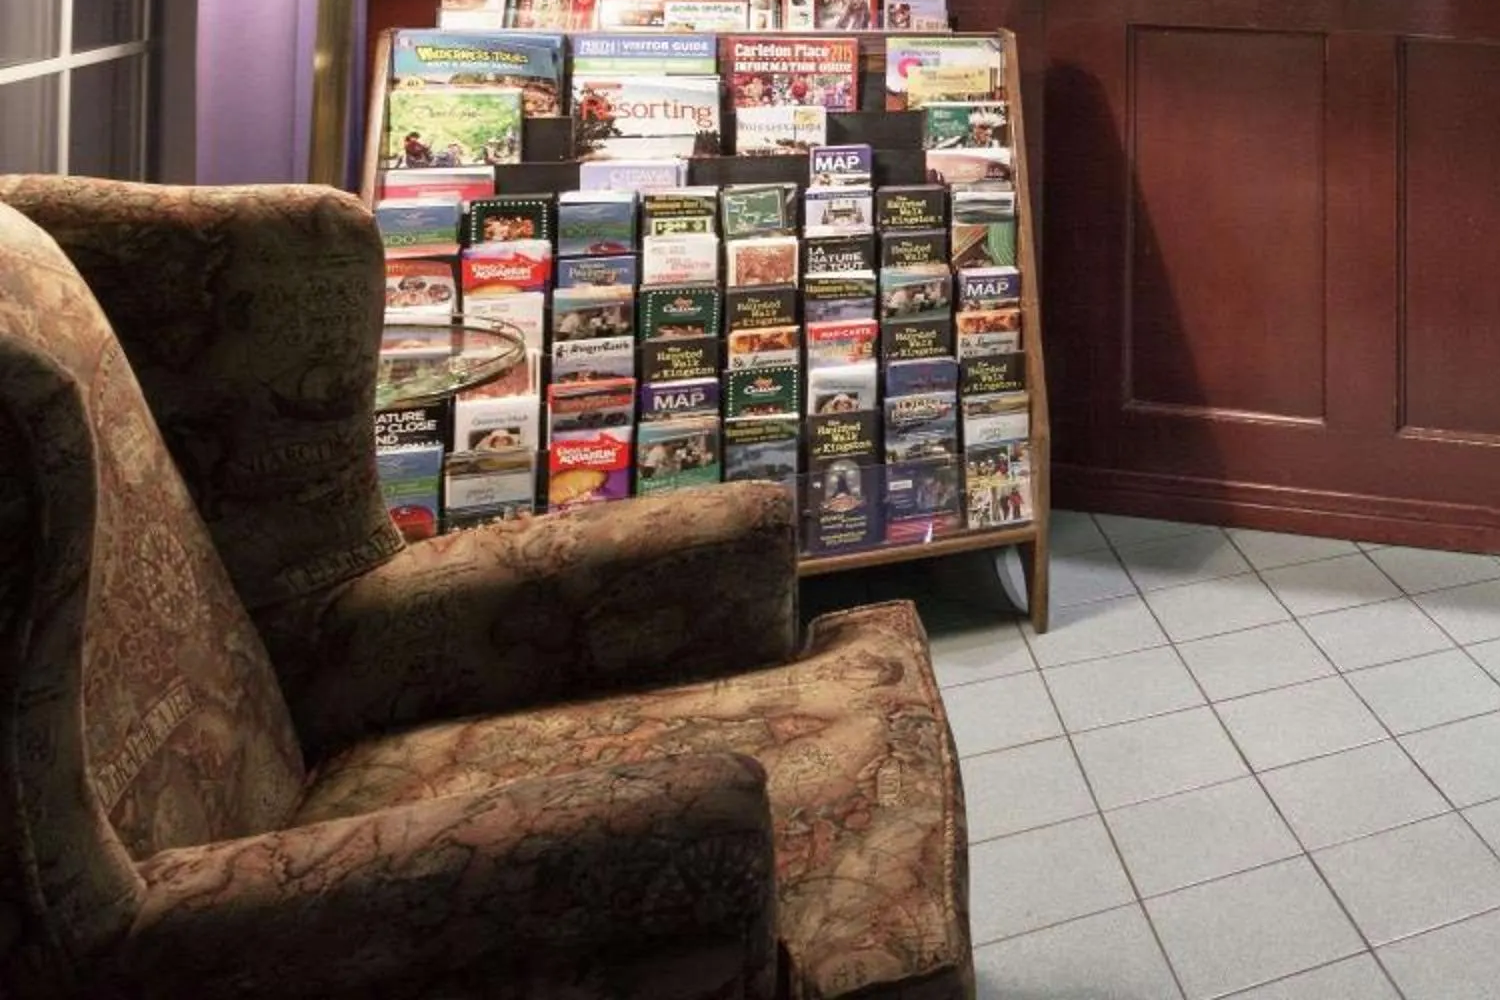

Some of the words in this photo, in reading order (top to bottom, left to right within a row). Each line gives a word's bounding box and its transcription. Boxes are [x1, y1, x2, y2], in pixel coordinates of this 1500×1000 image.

[622, 41, 669, 50] VISITOR
[672, 40, 708, 50] GUIDE
[735, 43, 793, 57] Carleton
[795, 43, 828, 57] Place
[735, 62, 817, 72] INFORMATION
[819, 62, 852, 73] GUIDE
[580, 96, 713, 128] Resorting
[815, 155, 860, 171] MAP
[809, 254, 863, 263] NATURE
[829, 262, 865, 271] TOUT
[966, 282, 1009, 297] MAP
[657, 350, 702, 361] Haunted
[654, 394, 705, 410] MAP
[375, 411, 426, 424] ATURE
[389, 421, 437, 433] CLOSE
[817, 424, 860, 434] Haunted
[824, 441, 872, 452] Kingston
